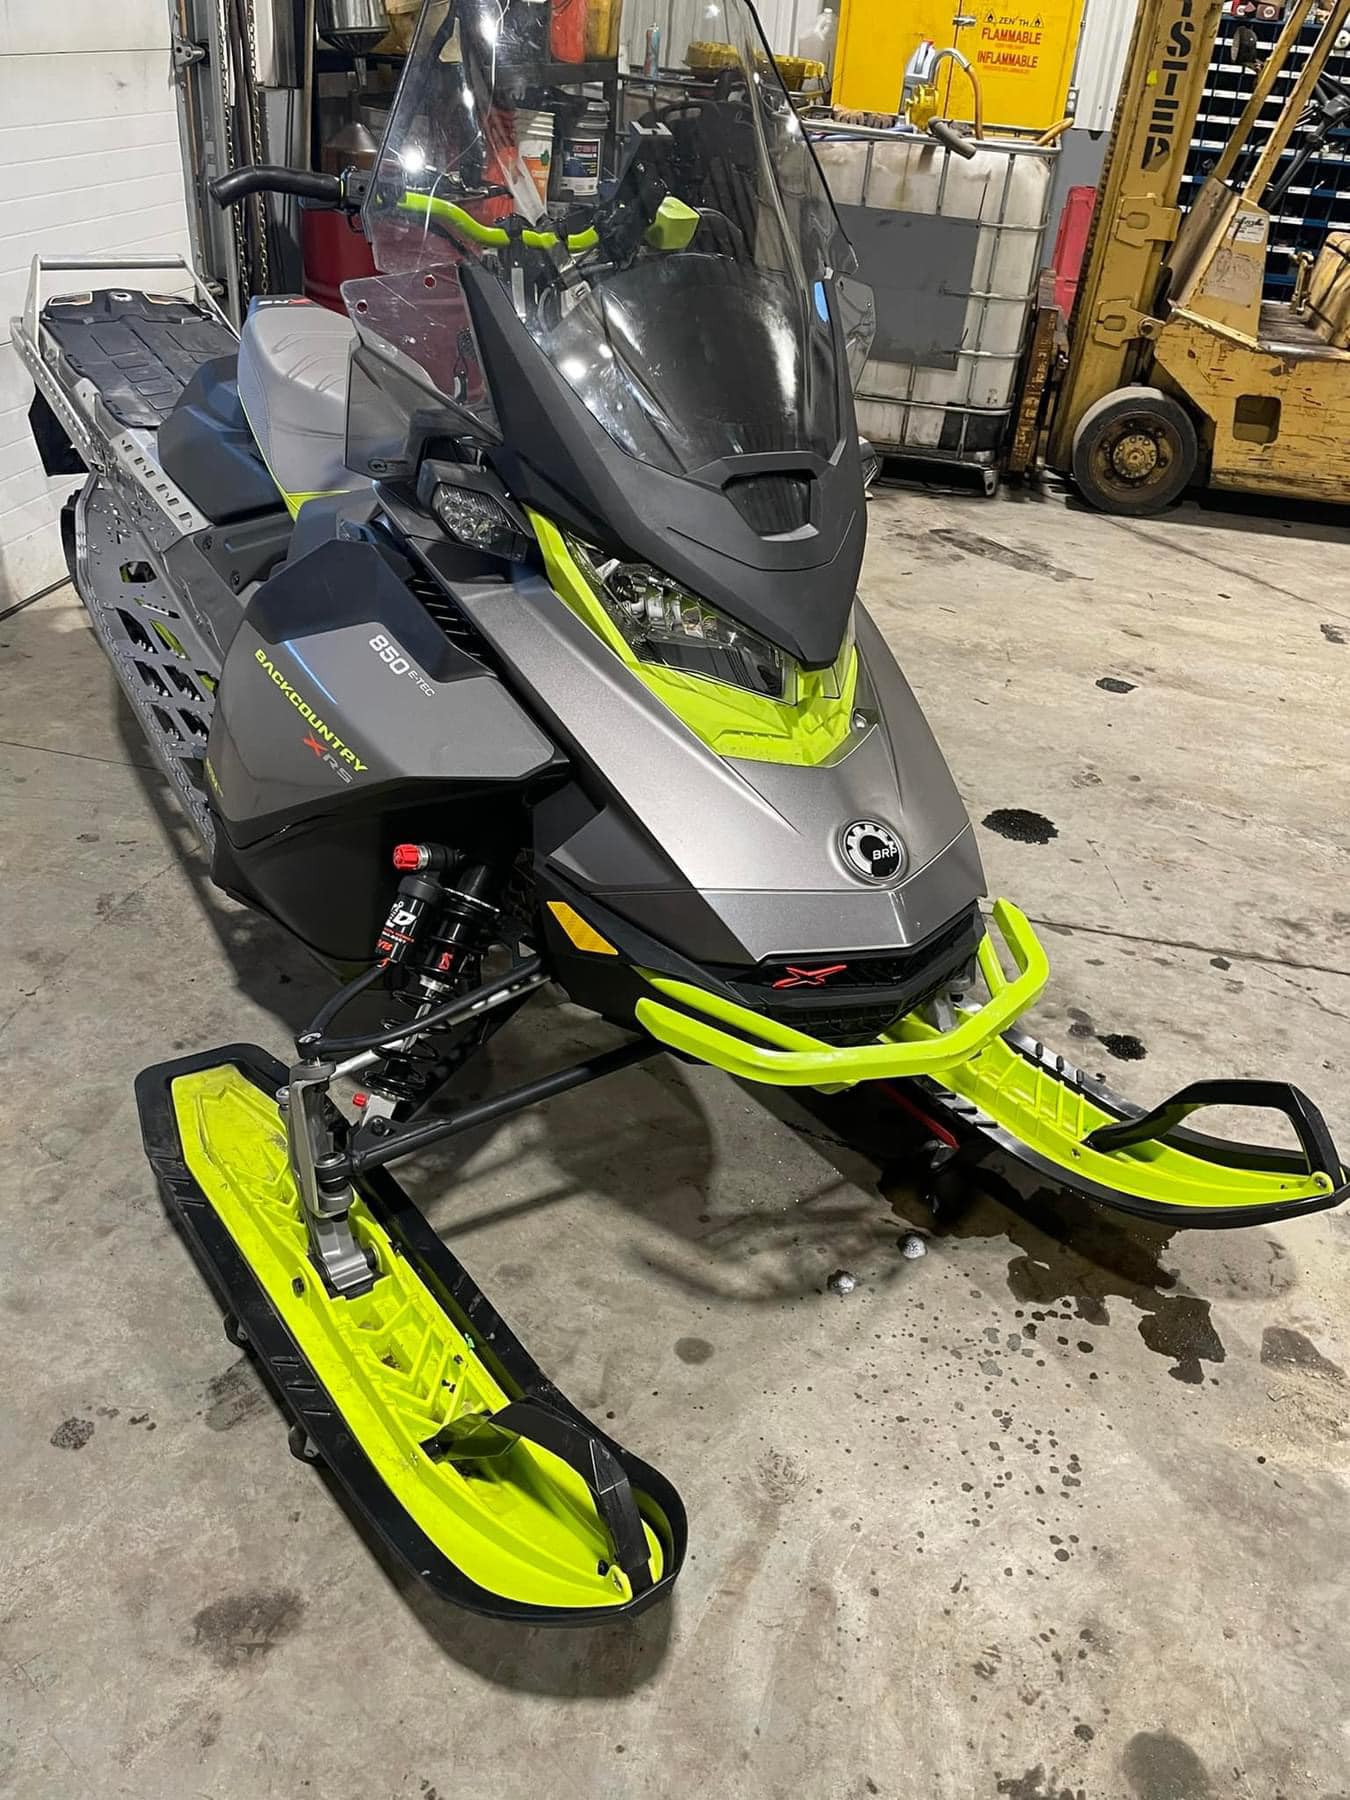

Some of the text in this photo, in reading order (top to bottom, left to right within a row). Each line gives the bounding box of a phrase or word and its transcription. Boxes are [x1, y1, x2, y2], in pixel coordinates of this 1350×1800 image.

[981, 27, 1042, 45] FLAMMABLE
[977, 50, 1039, 68] INFLAMMABLE
[368, 634, 436, 697] 850 E-TEC
[254, 648, 369, 773] BACKCOUNTRY
[871, 846, 898, 861] BRP
